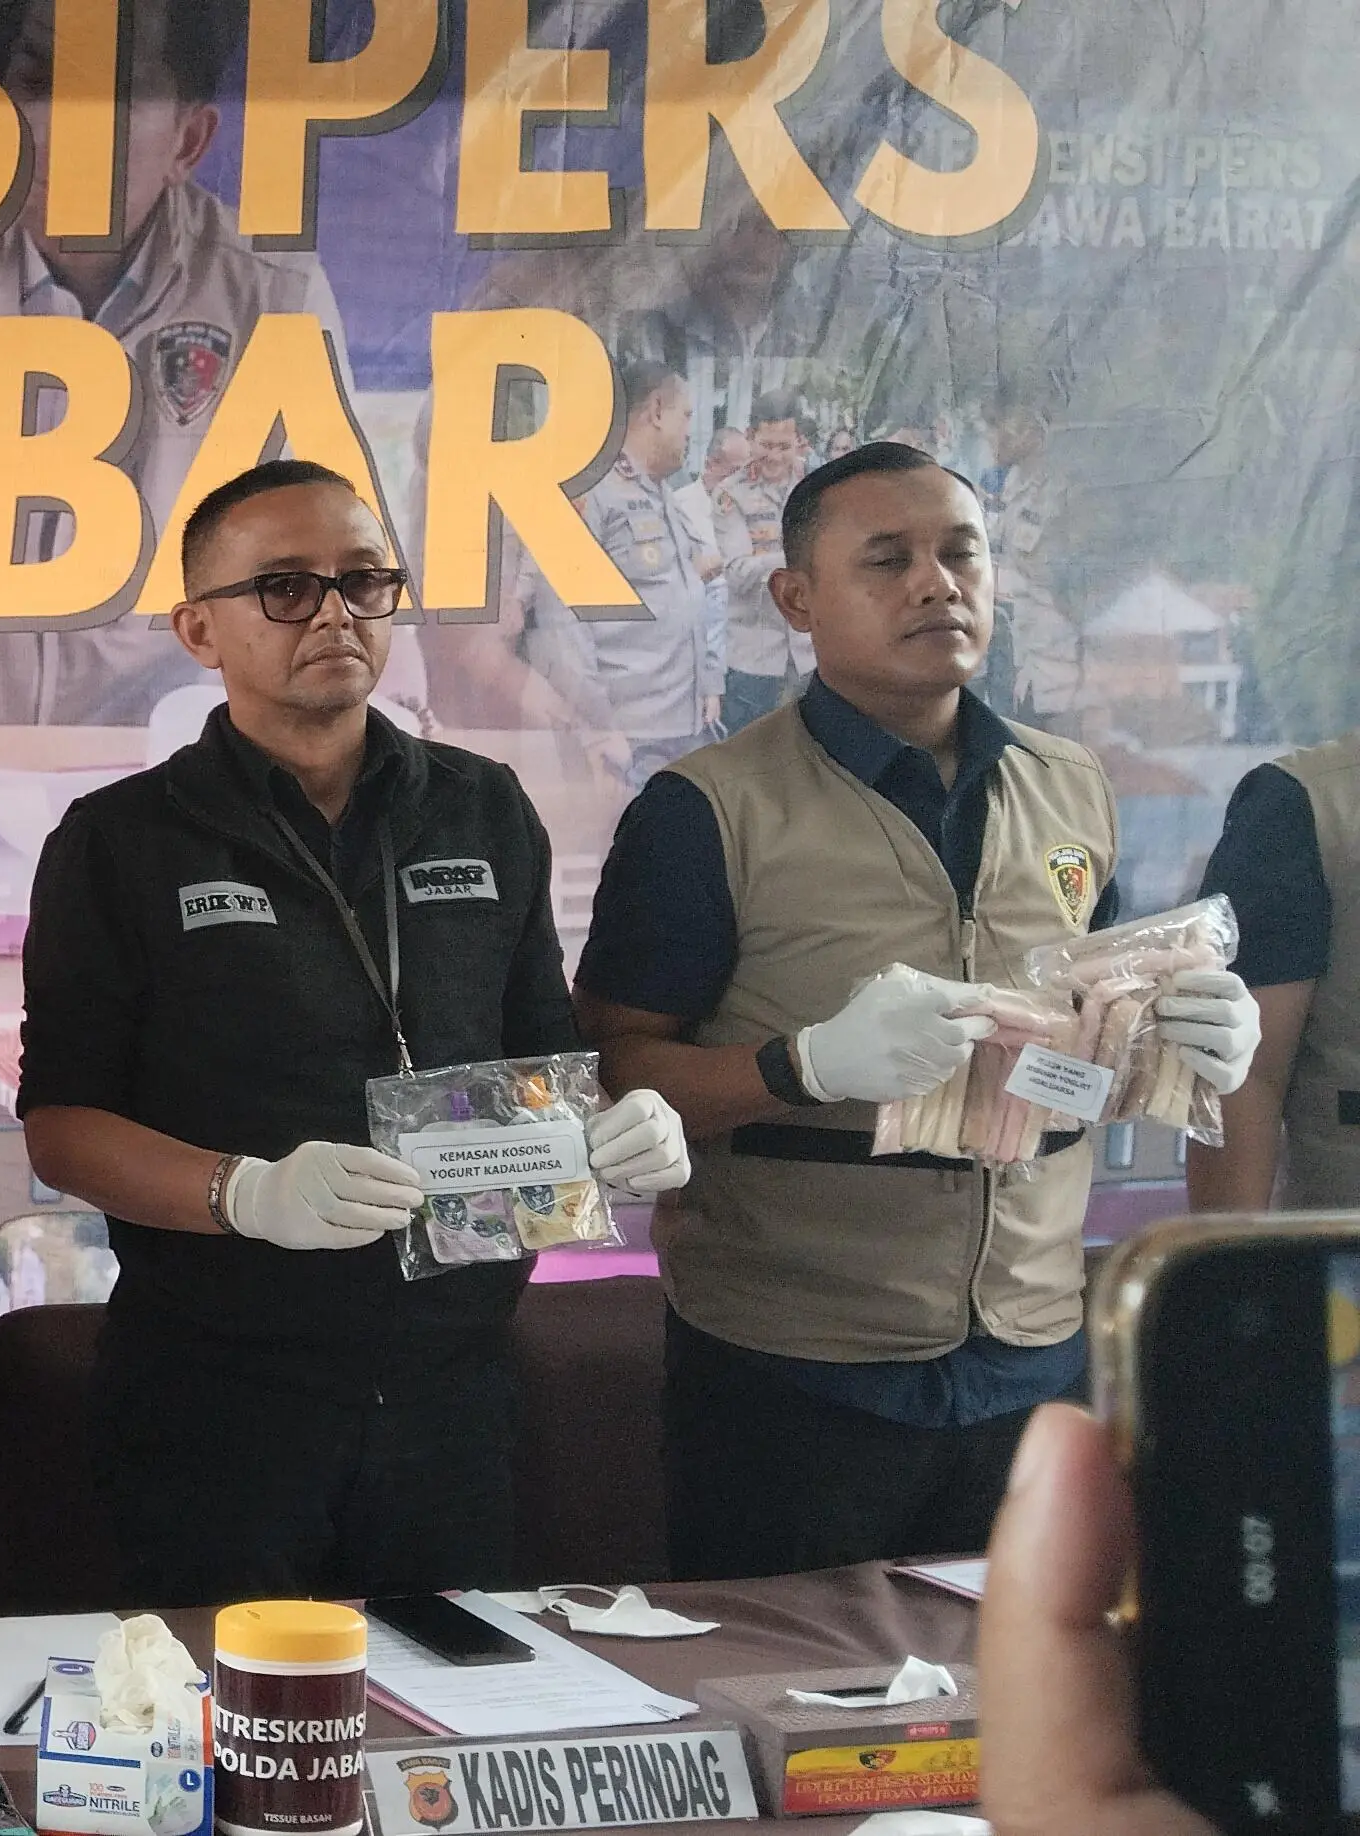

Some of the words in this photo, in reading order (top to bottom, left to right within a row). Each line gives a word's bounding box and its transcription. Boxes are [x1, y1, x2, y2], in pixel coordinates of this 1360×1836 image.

[239, 0, 1039, 237] PERS
[425, 885, 474, 896] JABAR
[184, 893, 232, 917] ERIK
[439, 1148, 499, 1163] KEMASAN
[501, 1143, 551, 1158] KOSONG
[430, 1166, 480, 1180] YOGURT
[483, 1159, 562, 1176] KADALUARSA
[458, 1747, 565, 1830] KADIS
[564, 1739, 732, 1823] PERINDAG
[89, 1797, 141, 1813] NITRILE
[263, 1812, 299, 1824] TISSUE
